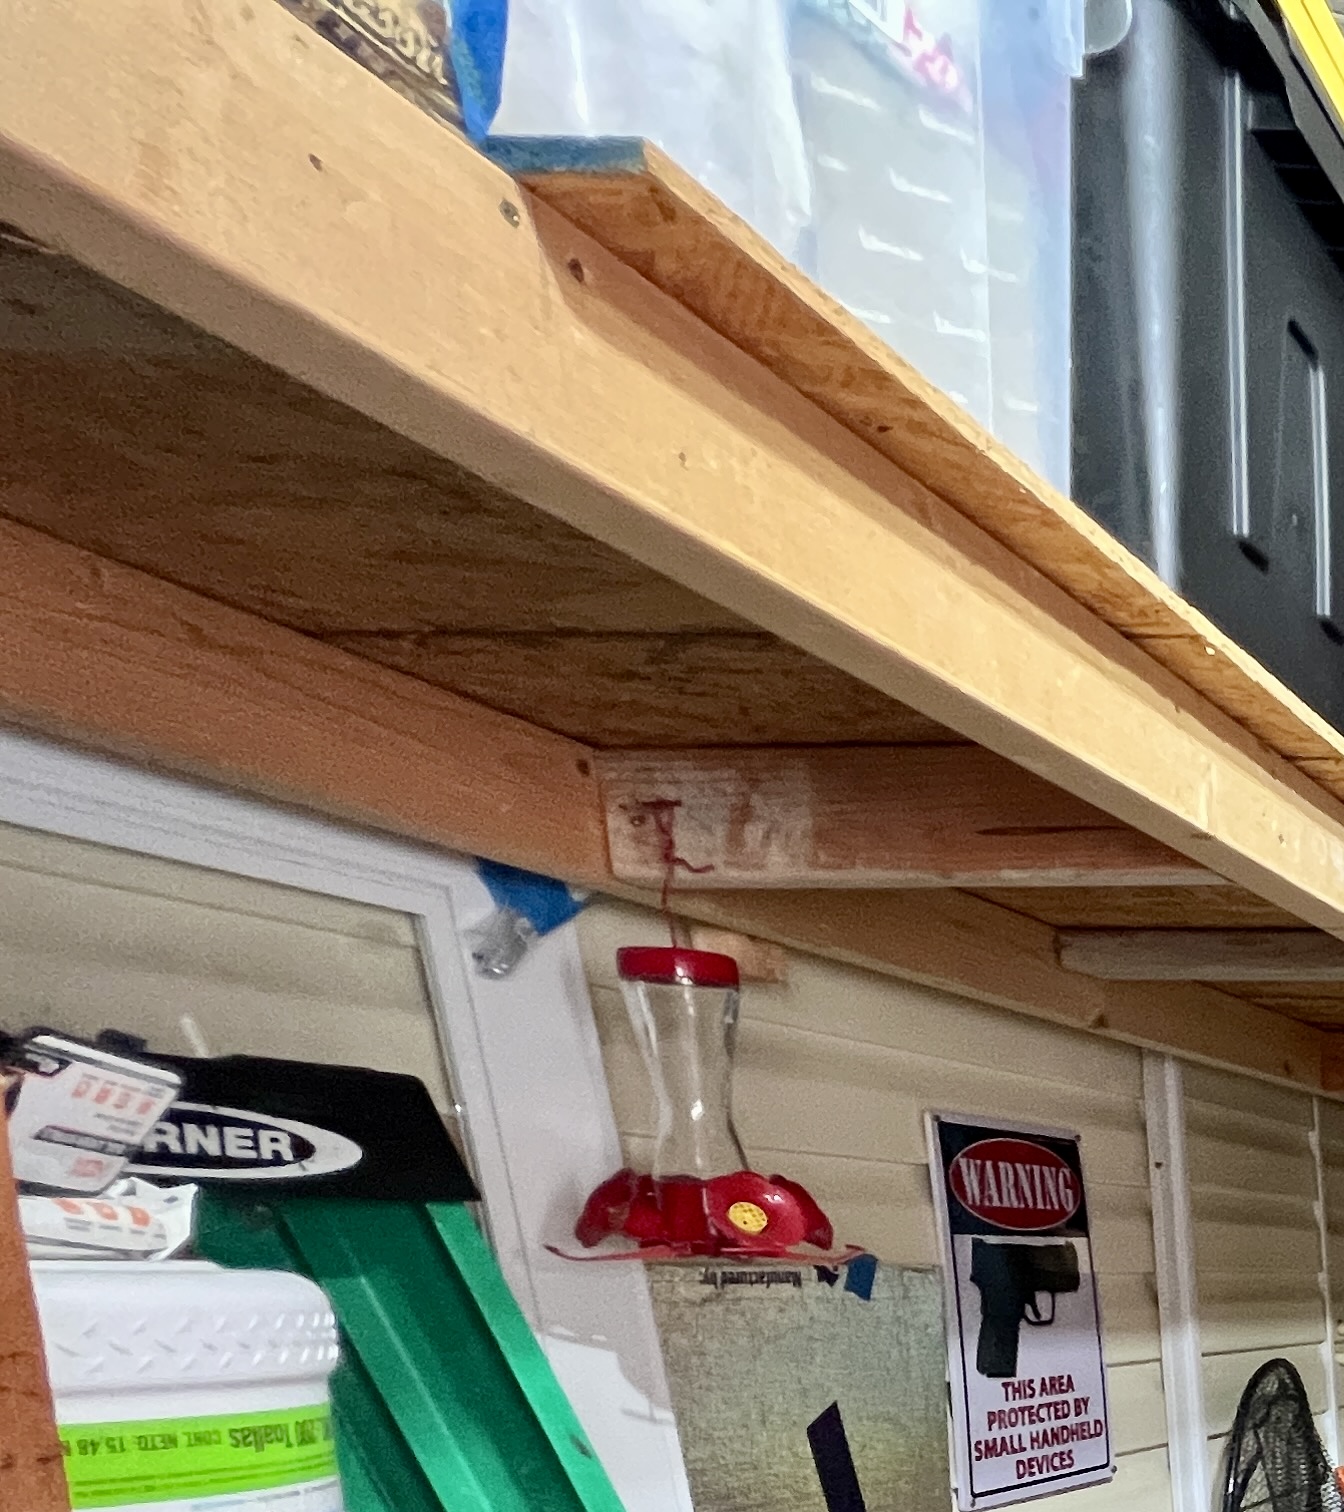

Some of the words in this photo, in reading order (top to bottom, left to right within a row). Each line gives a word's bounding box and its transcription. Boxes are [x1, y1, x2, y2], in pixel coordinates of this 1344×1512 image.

[144, 1121, 296, 1163] RNER
[958, 1156, 1075, 1212] WARNING
[1001, 1380, 1037, 1402] THIS
[1039, 1374, 1075, 1396] AREA
[987, 1403, 1071, 1431] PROTECTED
[1073, 1397, 1090, 1417] BY
[974, 1435, 1027, 1462] SMALL
[1029, 1419, 1104, 1449] HANDHELD
[1015, 1456, 1075, 1480] DEVICES
